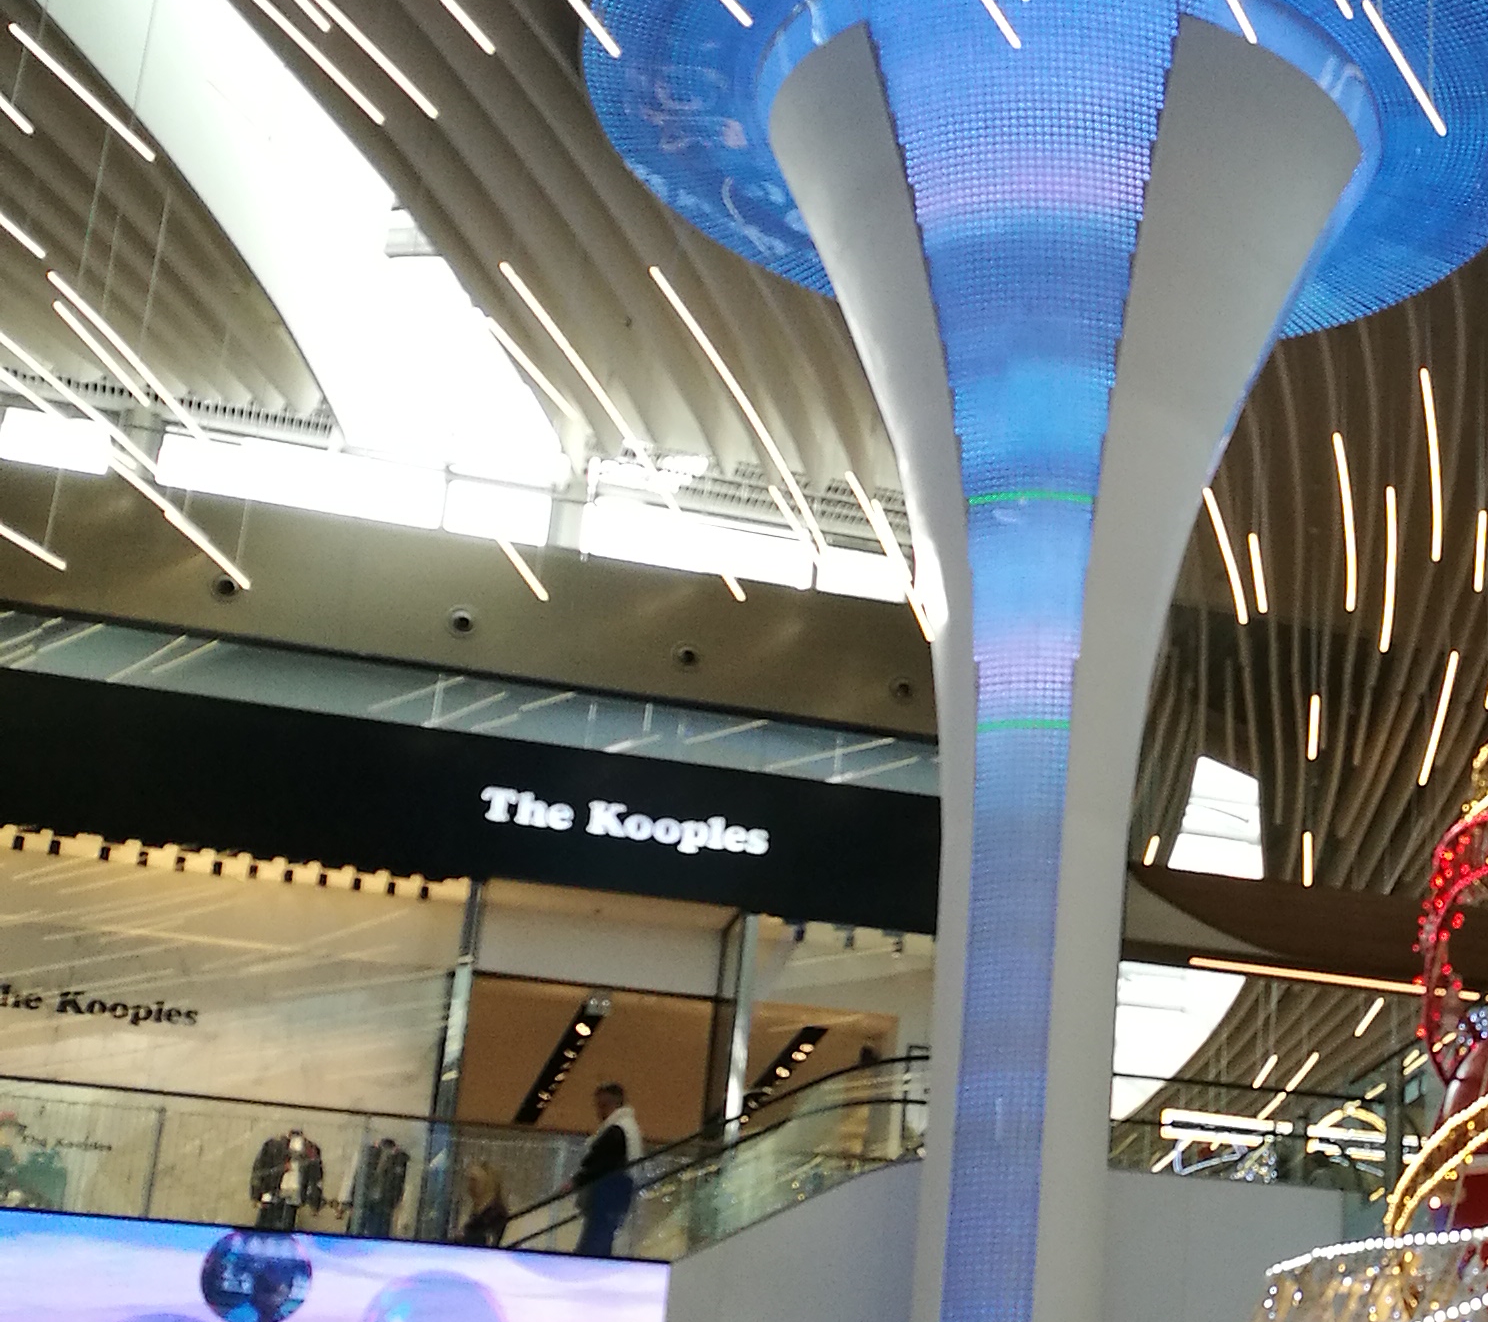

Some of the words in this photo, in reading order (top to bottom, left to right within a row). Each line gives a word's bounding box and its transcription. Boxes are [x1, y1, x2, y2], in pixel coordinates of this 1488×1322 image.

[480, 785, 575, 831] The
[585, 799, 770, 855] Kooples
[0, 983, 43, 1011] he
[56, 991, 199, 1026] Kooples
